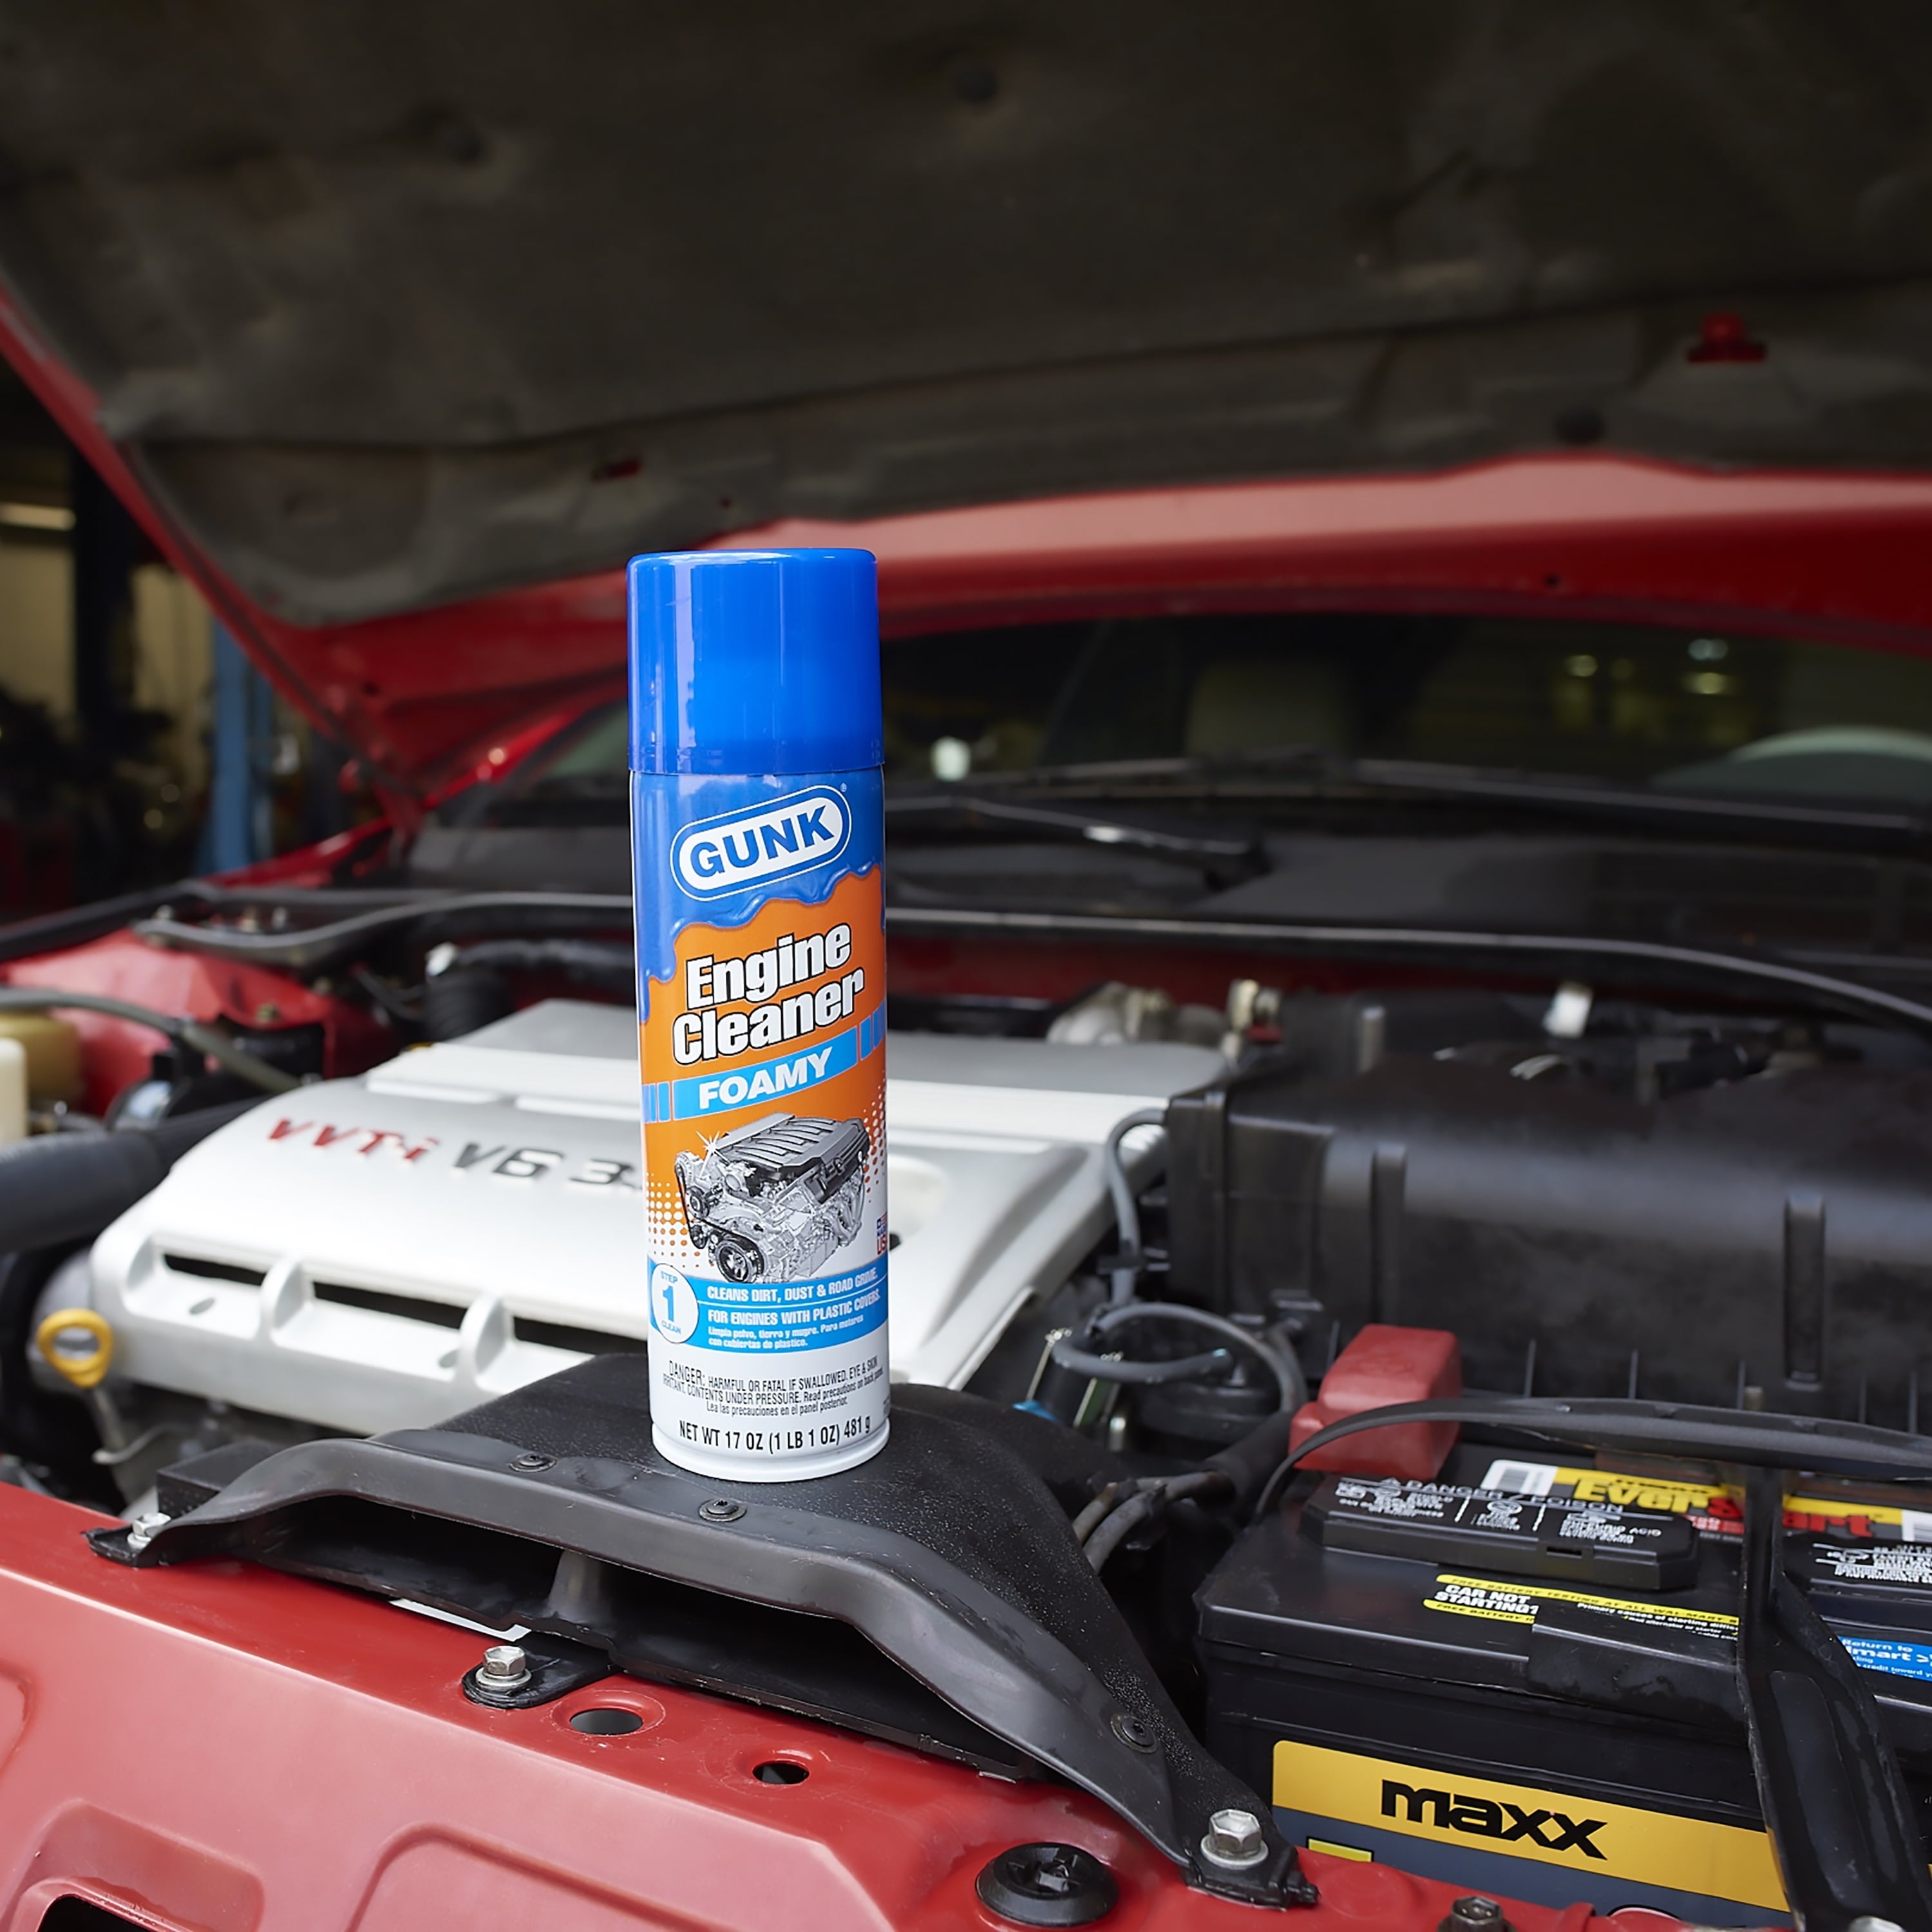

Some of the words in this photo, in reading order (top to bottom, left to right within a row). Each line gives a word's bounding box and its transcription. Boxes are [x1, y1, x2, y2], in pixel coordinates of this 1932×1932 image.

[690, 804, 835, 878] GUNK
[686, 922, 851, 1010] Engine
[672, 967, 864, 1065] Cleaner
[699, 1046, 833, 1109] FOAMY
[453, 1142, 565, 1179] V6
[661, 1271, 677, 1283] STEP
[707, 1286, 749, 1301] CLEANS
[752, 1289, 781, 1303] DIRT,
[784, 1286, 813, 1301] DUST
[817, 1284, 826, 1297] &
[828, 1278, 853, 1294] ROAD
[663, 1285, 674, 1322] 1
[708, 1309, 728, 1323] FOR
[730, 1312, 778, 1325] ENGINES
[781, 1310, 810, 1325] WITH
[813, 1301, 852, 1321] PLASTIC
[661, 1320, 681, 1334] CLEAN
[708, 1326, 732, 1338] Limpia
[733, 1330, 757, 1340] polvo,
[759, 1329, 783, 1338] tierra
[792, 1327, 819, 1337] mugre.
[820, 1323, 837, 1333] Para
[839, 1314, 864, 1329] motores
[709, 1338, 722, 1346] con
[723, 1338, 761, 1349] cubiertas
[762, 1340, 772, 1349] de
[669, 1360, 705, 1386] DANGER:
[708, 1376, 746, 1391] HARMFUL
[748, 1379, 760, 1392] OR
[762, 1379, 786, 1392] FATAL
[789, 1379, 797, 1390] IF
[799, 1370, 848, 1390] SWALLOWED.
[849, 1364, 860, 1379] EYE
[862, 1362, 866, 1374] &
[867, 1355, 878, 1371] SKIN
[687, 1384, 723, 1402] CONTENTS
[726, 1391, 753, 1404] UNDER
[756, 1392, 802, 1405] PRESSURE.
[804, 1390, 820, 1402] Read
[823, 1381, 856, 1400] precautions
[857, 1379, 863, 1389] on
[864, 1374, 873, 1385] back
[706, 1401, 718, 1413] Lea
[720, 1403, 730, 1414] las
[732, 1405, 779, 1417] precauciones
[781, 1406, 789, 1416] en
[791, 1404, 798, 1414] el
[799, 1402, 819, 1416] panel
[679, 1420, 698, 1441] NET
[701, 1426, 720, 1446] WT
[725, 1431, 741, 1449] 17
[746, 1432, 763, 1450] OZ
[769, 1432, 781, 1454] (1
[787, 1431, 803, 1449] LB
[808, 1428, 814, 1447] 1
[820, 1424, 840, 1445] OZ)
[844, 1416, 862, 1438] 481
[865, 1416, 871, 1434] g
[1573, 1477, 1872, 1537] EverSart
[1445, 1584, 1486, 1598] CAR
[1490, 1591, 1531, 1604] NOT
[1577, 1602, 1615, 1614] Primary
[1842, 1639, 1892, 1651] Return
[1897, 1645, 1913, 1653] to
[1381, 1778, 1608, 1861] maxx
